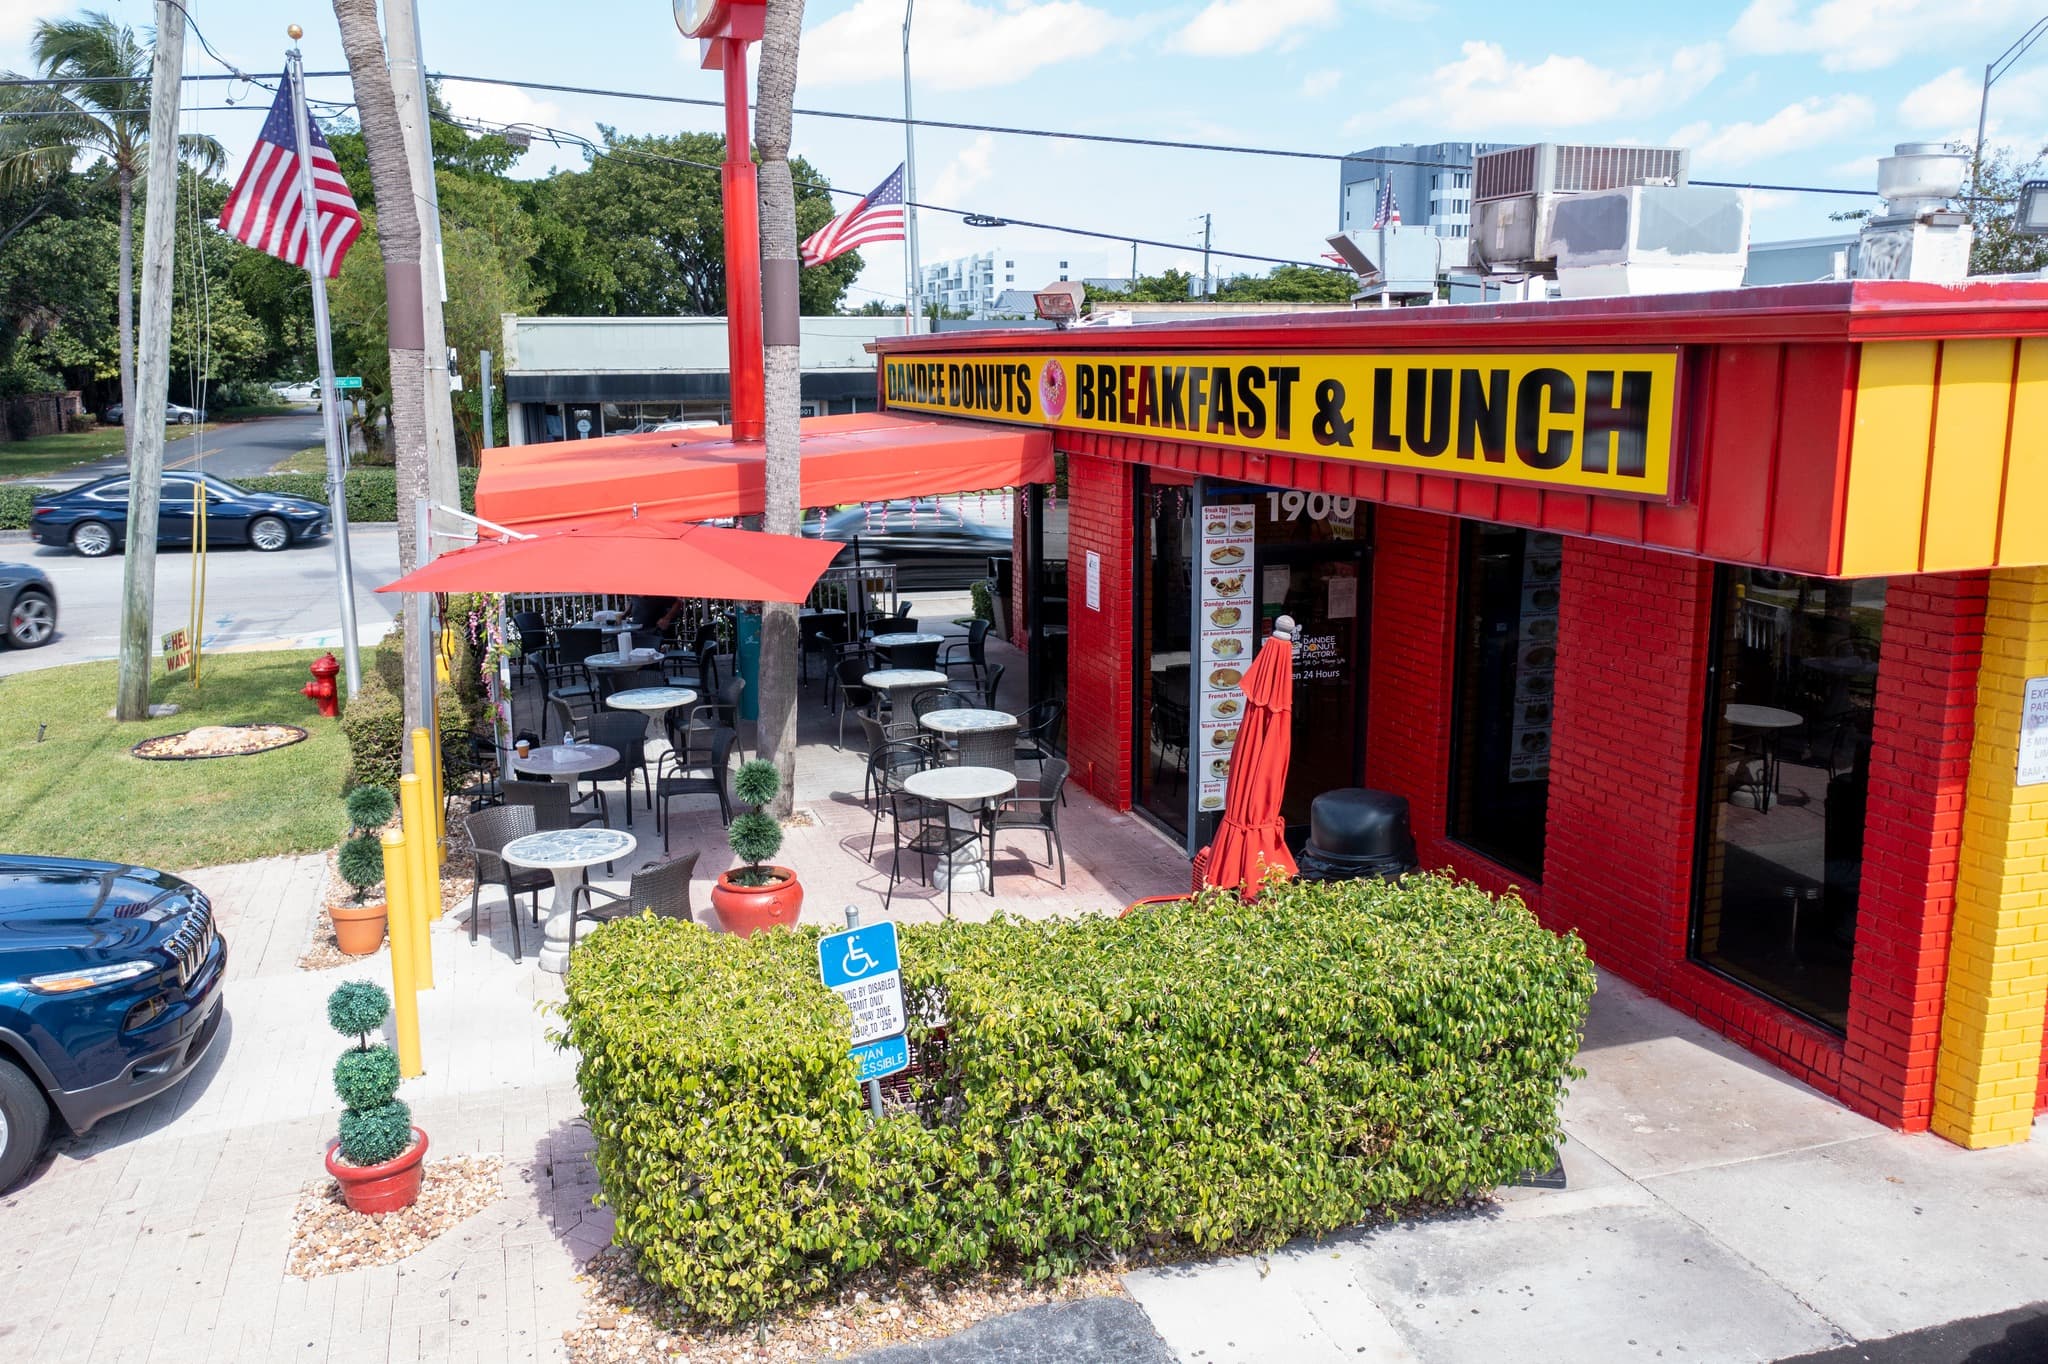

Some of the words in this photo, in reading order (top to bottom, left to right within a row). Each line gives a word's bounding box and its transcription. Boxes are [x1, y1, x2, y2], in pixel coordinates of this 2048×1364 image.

[887, 363, 945, 406] DANDEE
[949, 363, 1031, 416] DONUTS
[1076, 364, 1300, 439] BREAKFAST
[1312, 378, 1355, 447] &
[1372, 368, 1652, 478] LUNCH
[1266, 491, 1357, 522] 1900
[1303, 635, 1336, 644] DANDEE
[1303, 643, 1337, 652] DONUT
[1302, 650, 1335, 659] FACTORY
[1303, 670, 1314, 680] 24
[1315, 670, 1340, 678] Hours
[858, 985, 866, 997] BY
[868, 978, 895, 994] DISABLED
[870, 994, 884, 1007] ONLY
[876, 1004, 891, 1018] ZONE
[870, 1022, 878, 1033] TO
[860, 1046, 883, 1063] VAN
[862, 1052, 904, 1075] ESSIBLE
